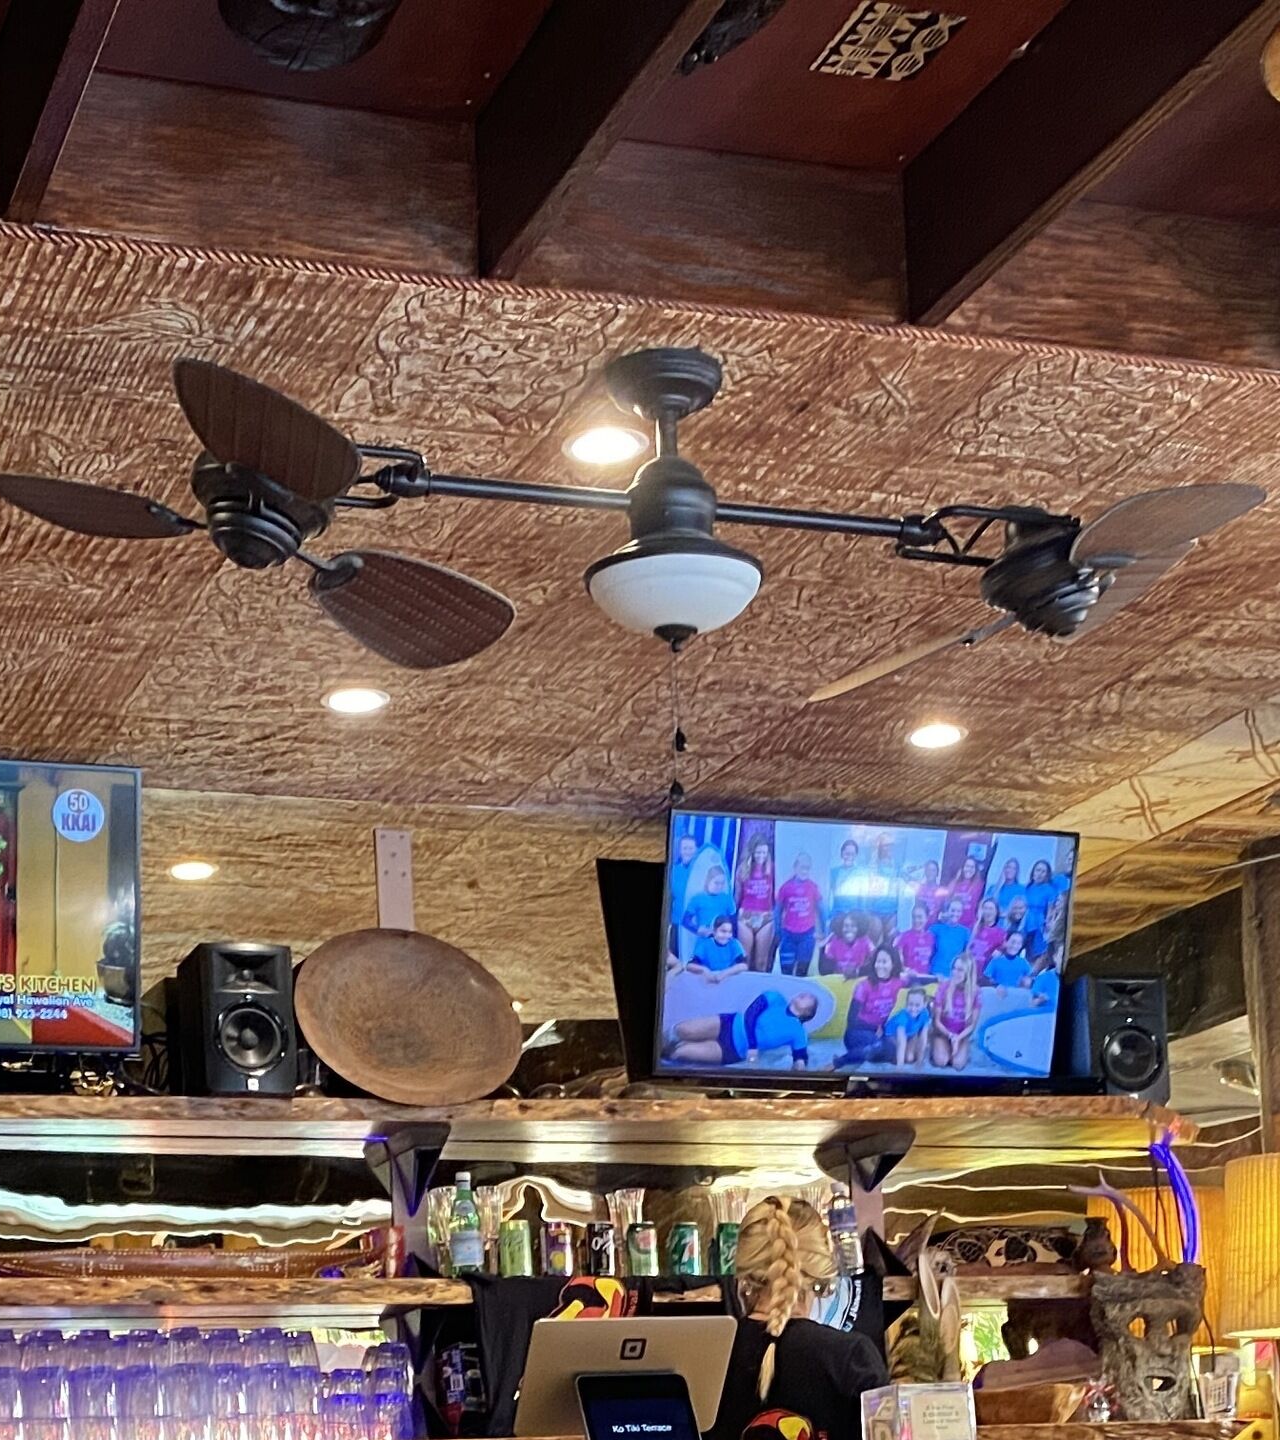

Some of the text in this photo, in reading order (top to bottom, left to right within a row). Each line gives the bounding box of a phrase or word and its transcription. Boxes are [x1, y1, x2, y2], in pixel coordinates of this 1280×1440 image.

[69, 793, 89, 812] 50
[61, 813, 96, 832] KKAI
[20, 976, 96, 994] KITCHEN
[17, 996, 69, 1006] Hawaiian
[73, 997, 93, 1007] Ave
[625, 1424, 640, 1432] Tiki
[641, 1424, 672, 1432] Terrace
